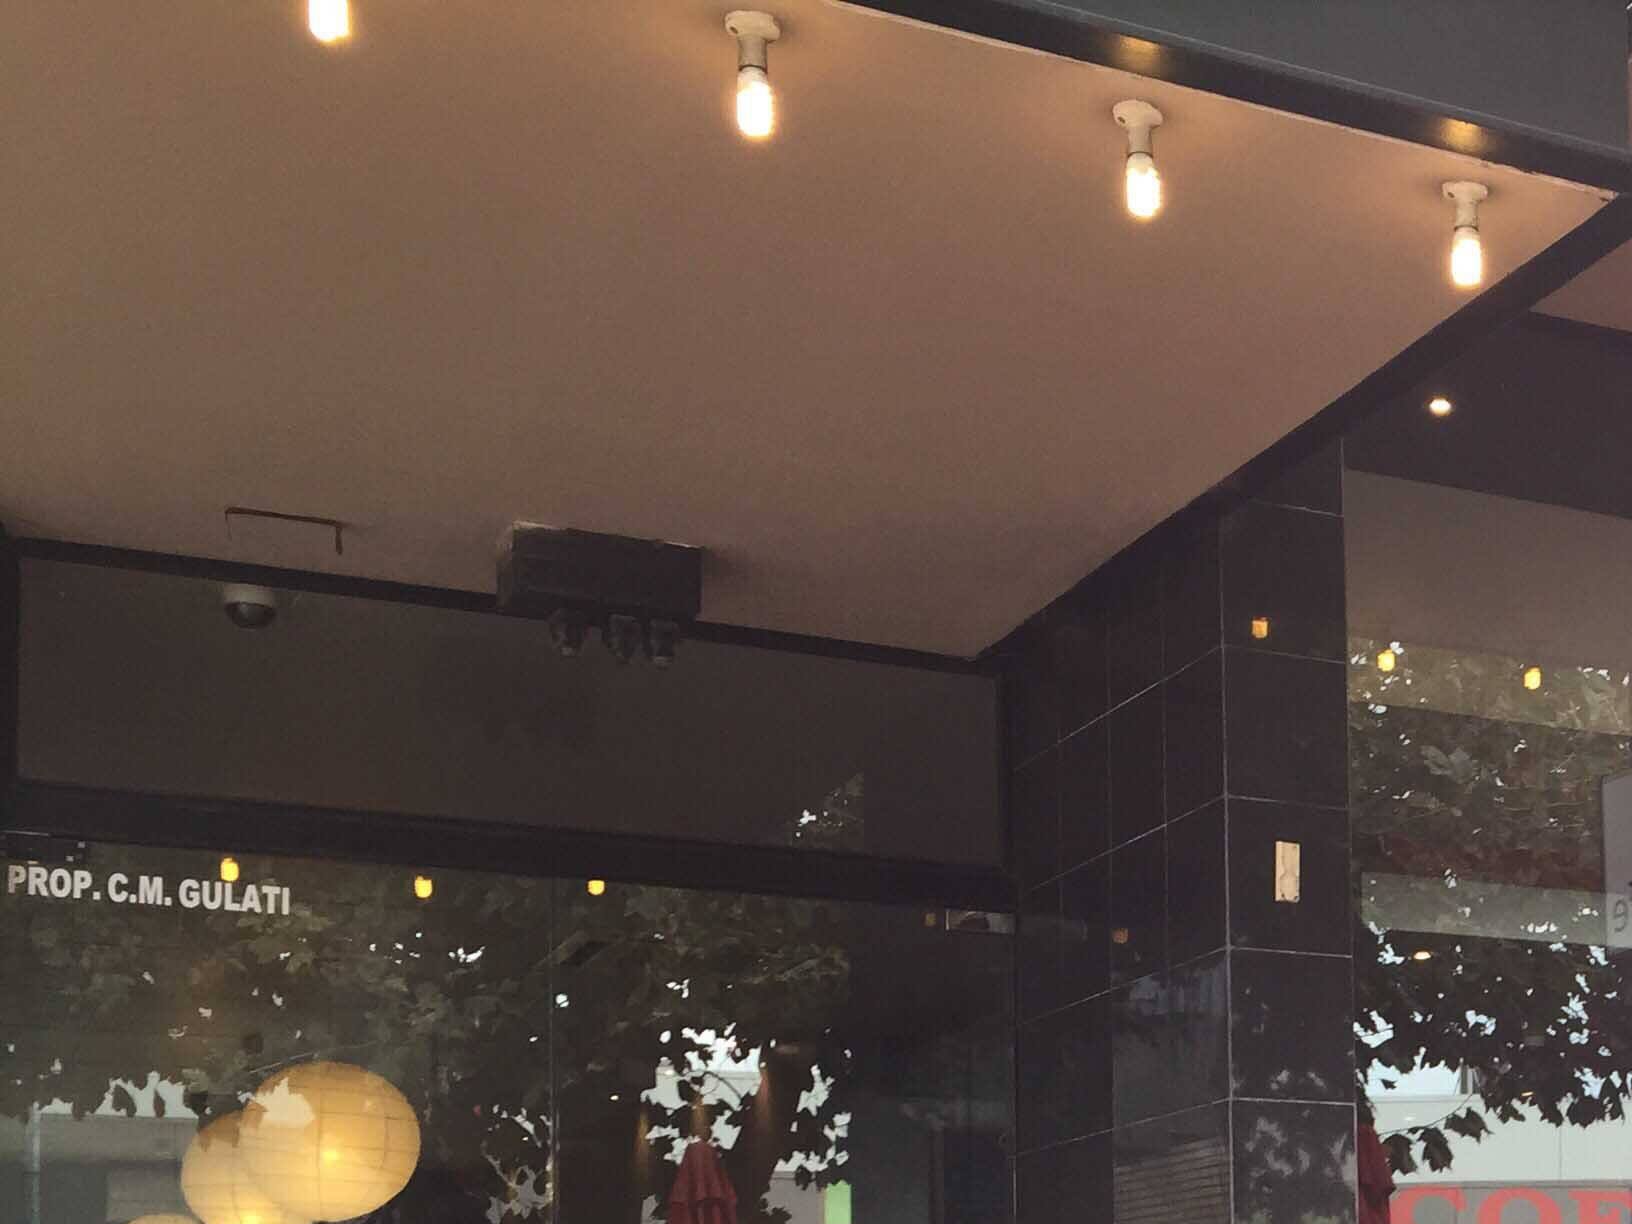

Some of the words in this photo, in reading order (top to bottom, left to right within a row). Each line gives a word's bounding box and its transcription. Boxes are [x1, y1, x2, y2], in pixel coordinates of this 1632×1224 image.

[8, 864, 100, 900] PROP.
[107, 872, 172, 906] C.M.
[178, 878, 291, 915] GULATI
